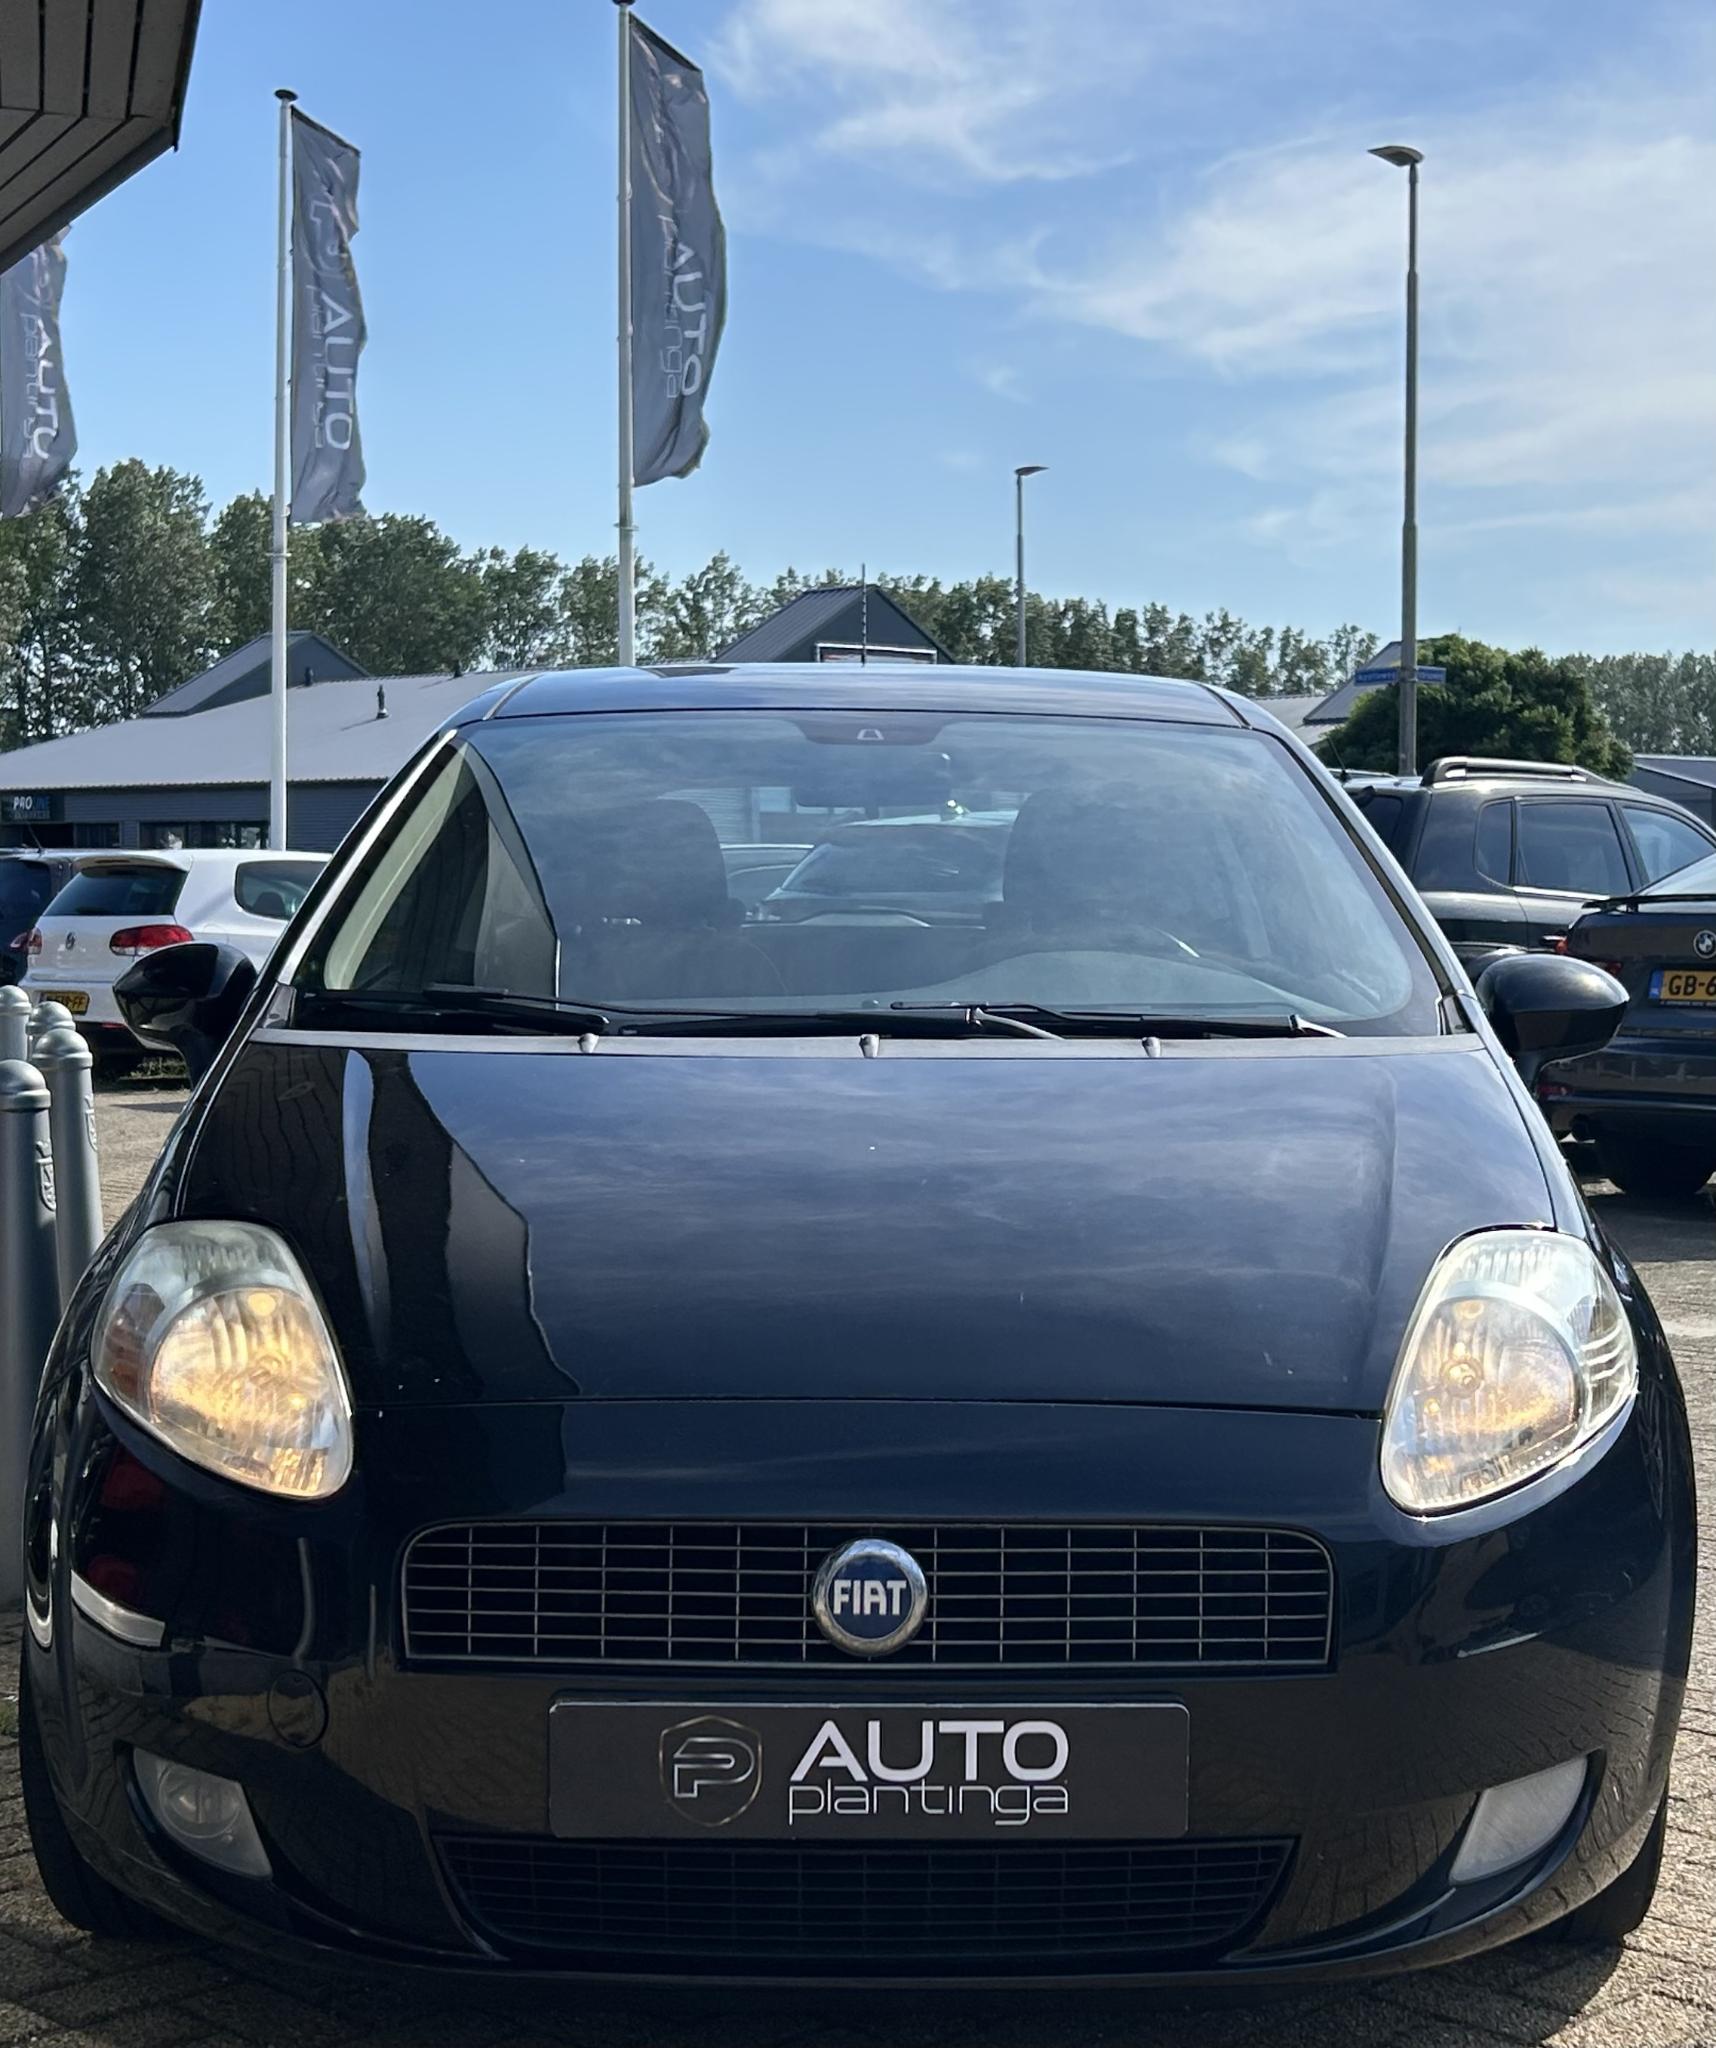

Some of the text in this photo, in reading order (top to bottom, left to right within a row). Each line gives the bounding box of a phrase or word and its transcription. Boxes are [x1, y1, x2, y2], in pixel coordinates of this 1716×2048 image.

[672, 242, 706, 396] AUTO
[33, 317, 59, 460] AUTO
[321, 291, 354, 450] AUTO
[1668, 974, 1716, 997] GB-6
[832, 1578, 907, 1616] FIAT
[790, 1719, 1070, 1783] AUTO
[788, 1777, 1070, 1826] plantinga
